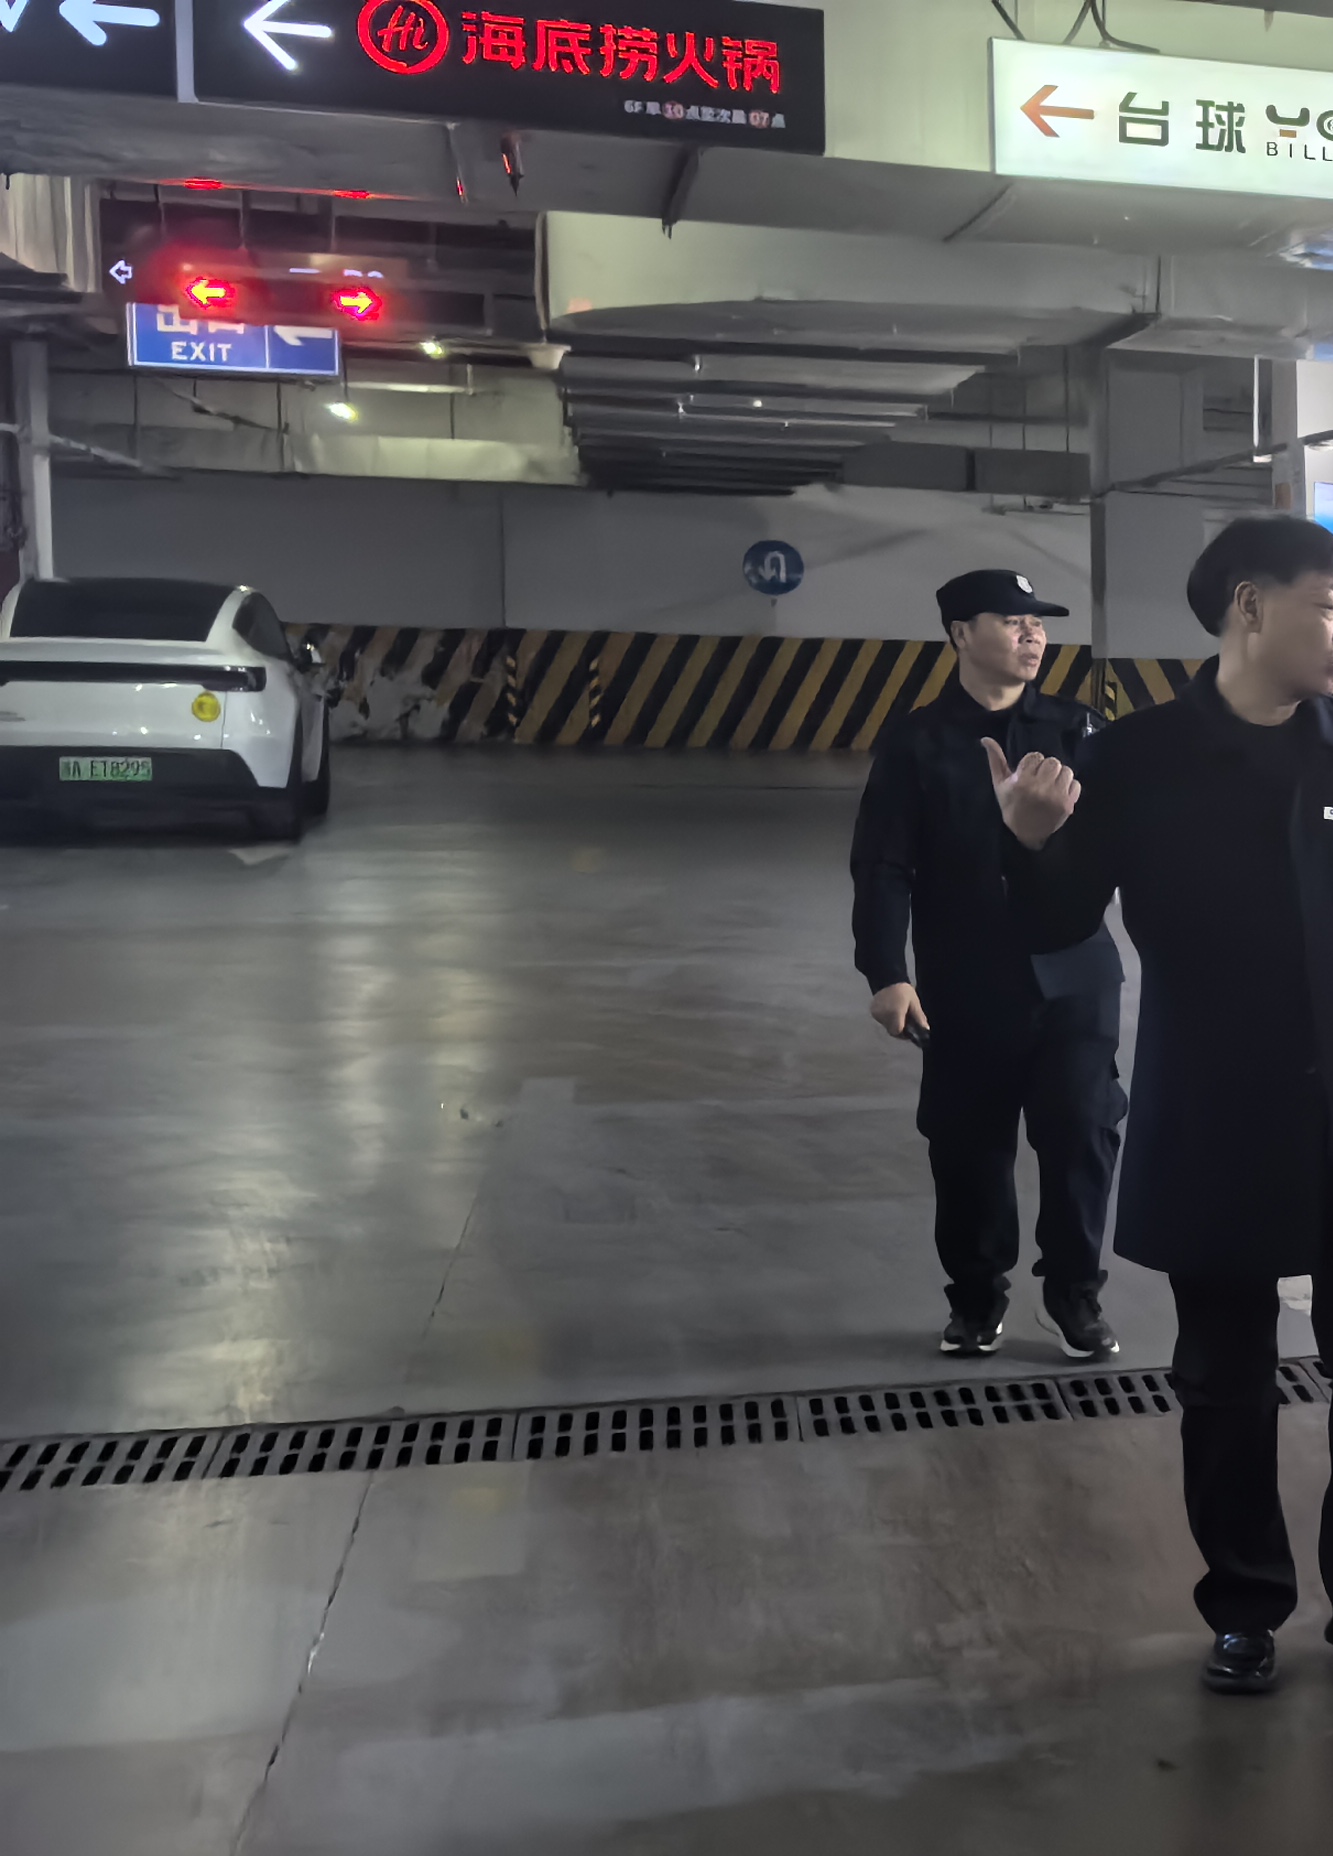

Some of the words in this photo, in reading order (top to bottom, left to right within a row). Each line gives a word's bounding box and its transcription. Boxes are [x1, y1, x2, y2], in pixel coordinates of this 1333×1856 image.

[461, 11, 782, 94] 海底捞火锅
[1118, 92, 1246, 153] 台球
[171, 341, 232, 363] EXIT
